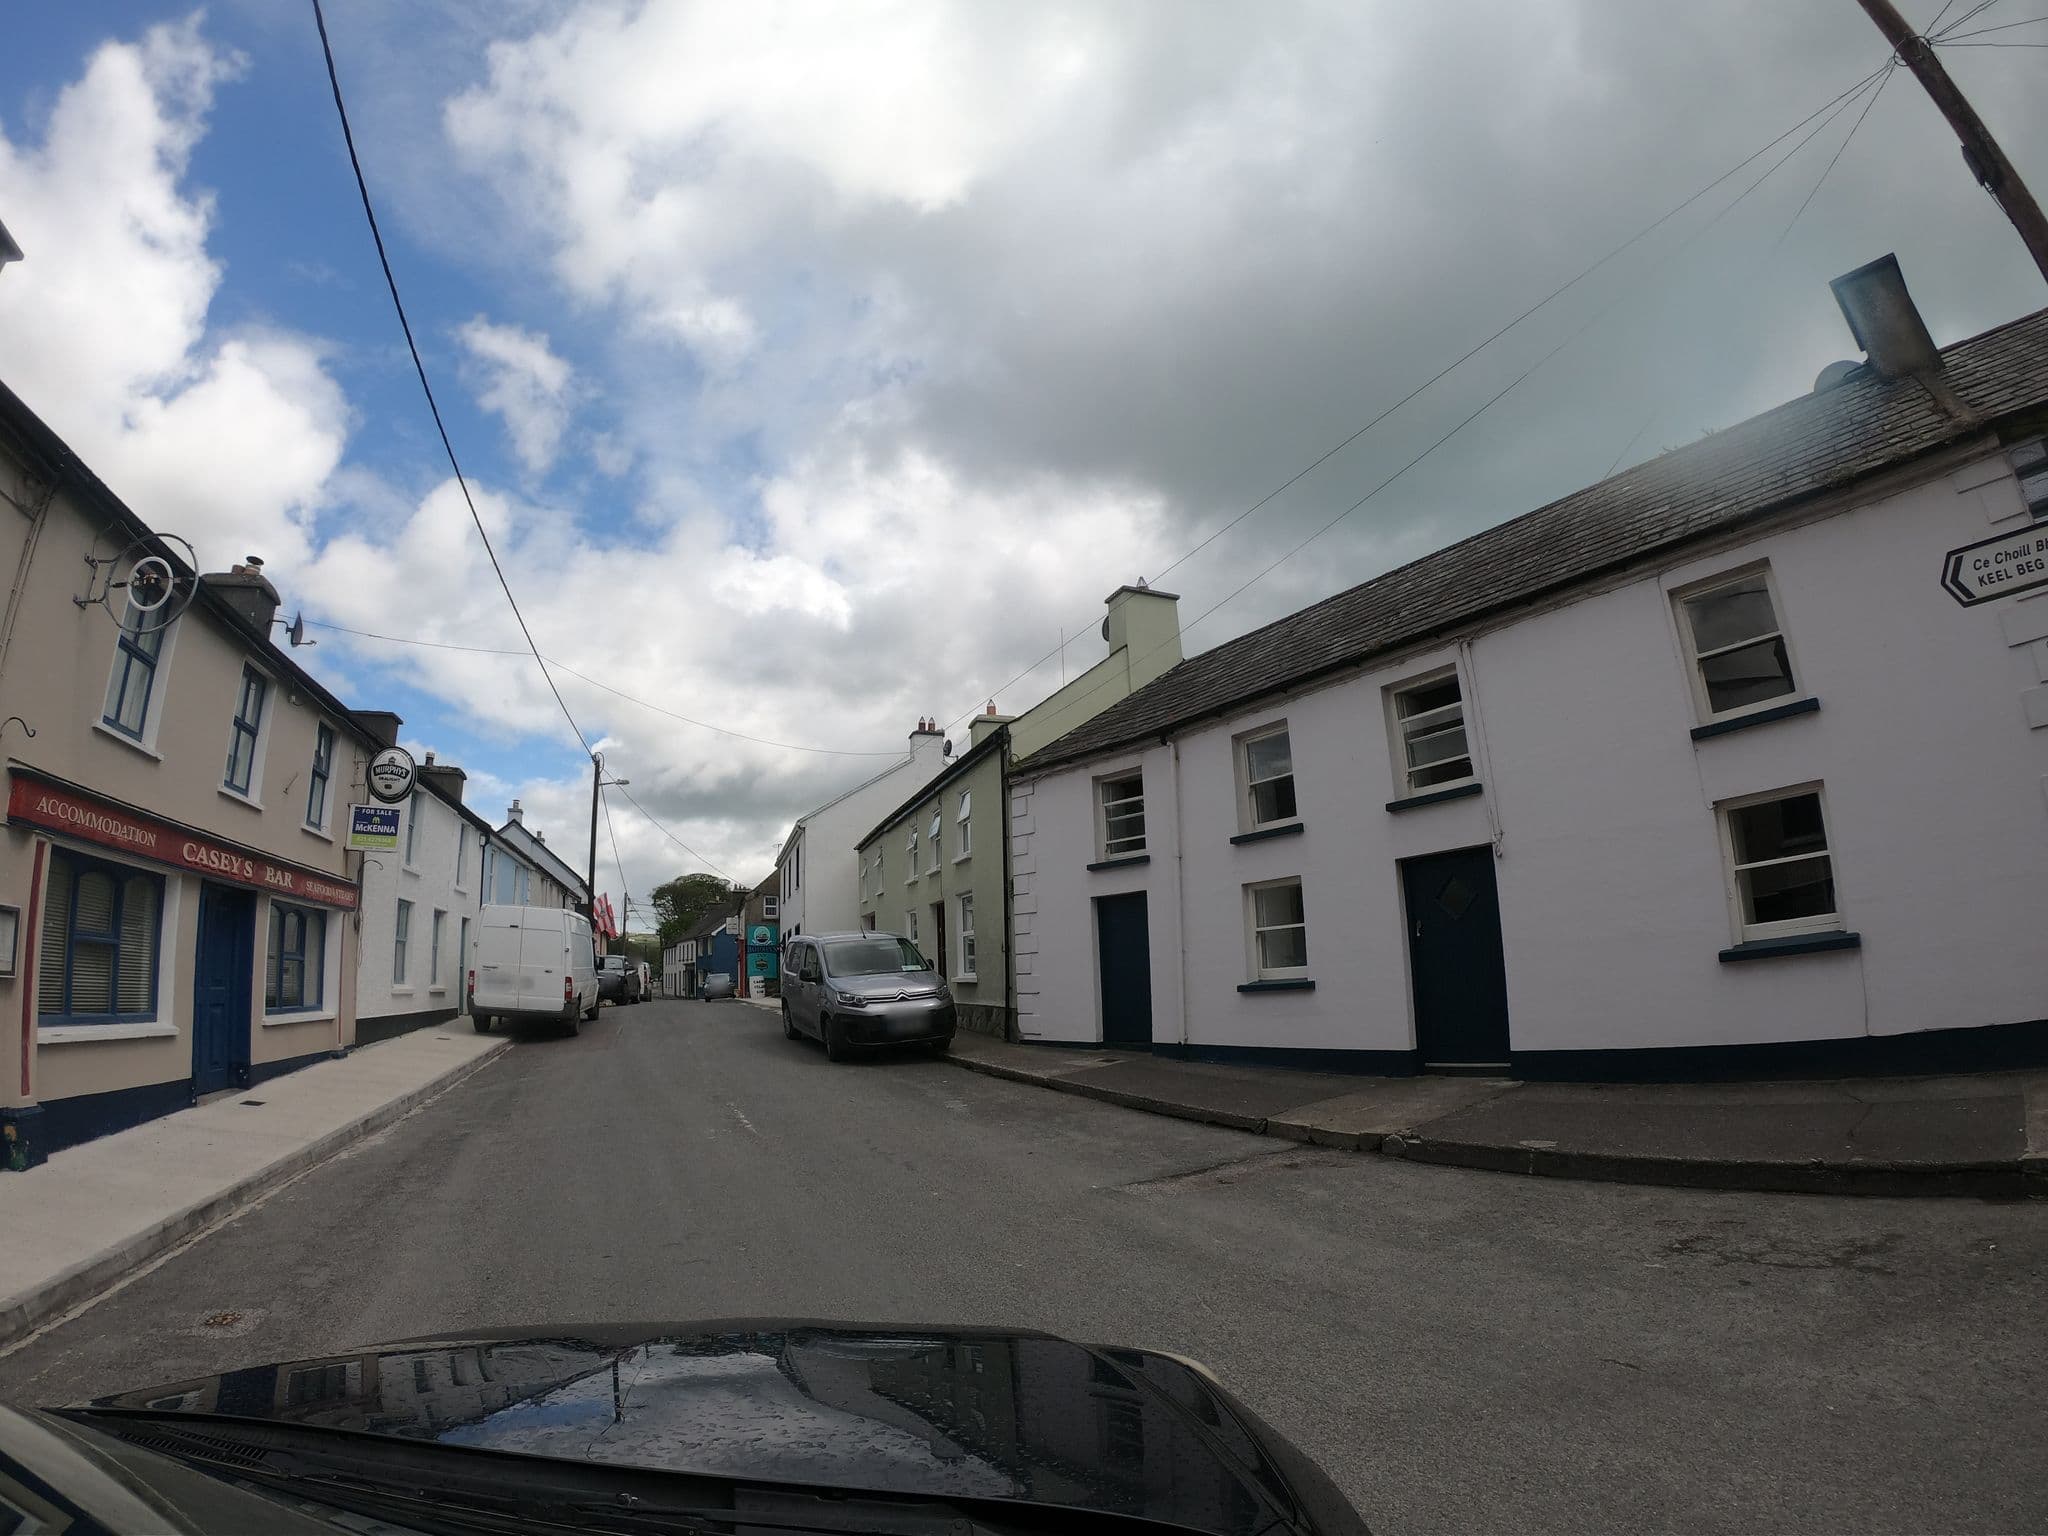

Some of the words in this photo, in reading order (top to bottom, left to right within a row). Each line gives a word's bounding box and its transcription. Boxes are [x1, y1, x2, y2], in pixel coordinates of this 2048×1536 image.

[1973, 558, 1990, 571] Ce
[1995, 544, 2031, 564] Choill
[1978, 568, 2013, 587] KEEL
[2016, 558, 2045, 575] BEG
[36, 796, 156, 847] ACCOMMODATION
[355, 823, 396, 834] McKENNA
[265, 865, 293, 888] BAR
